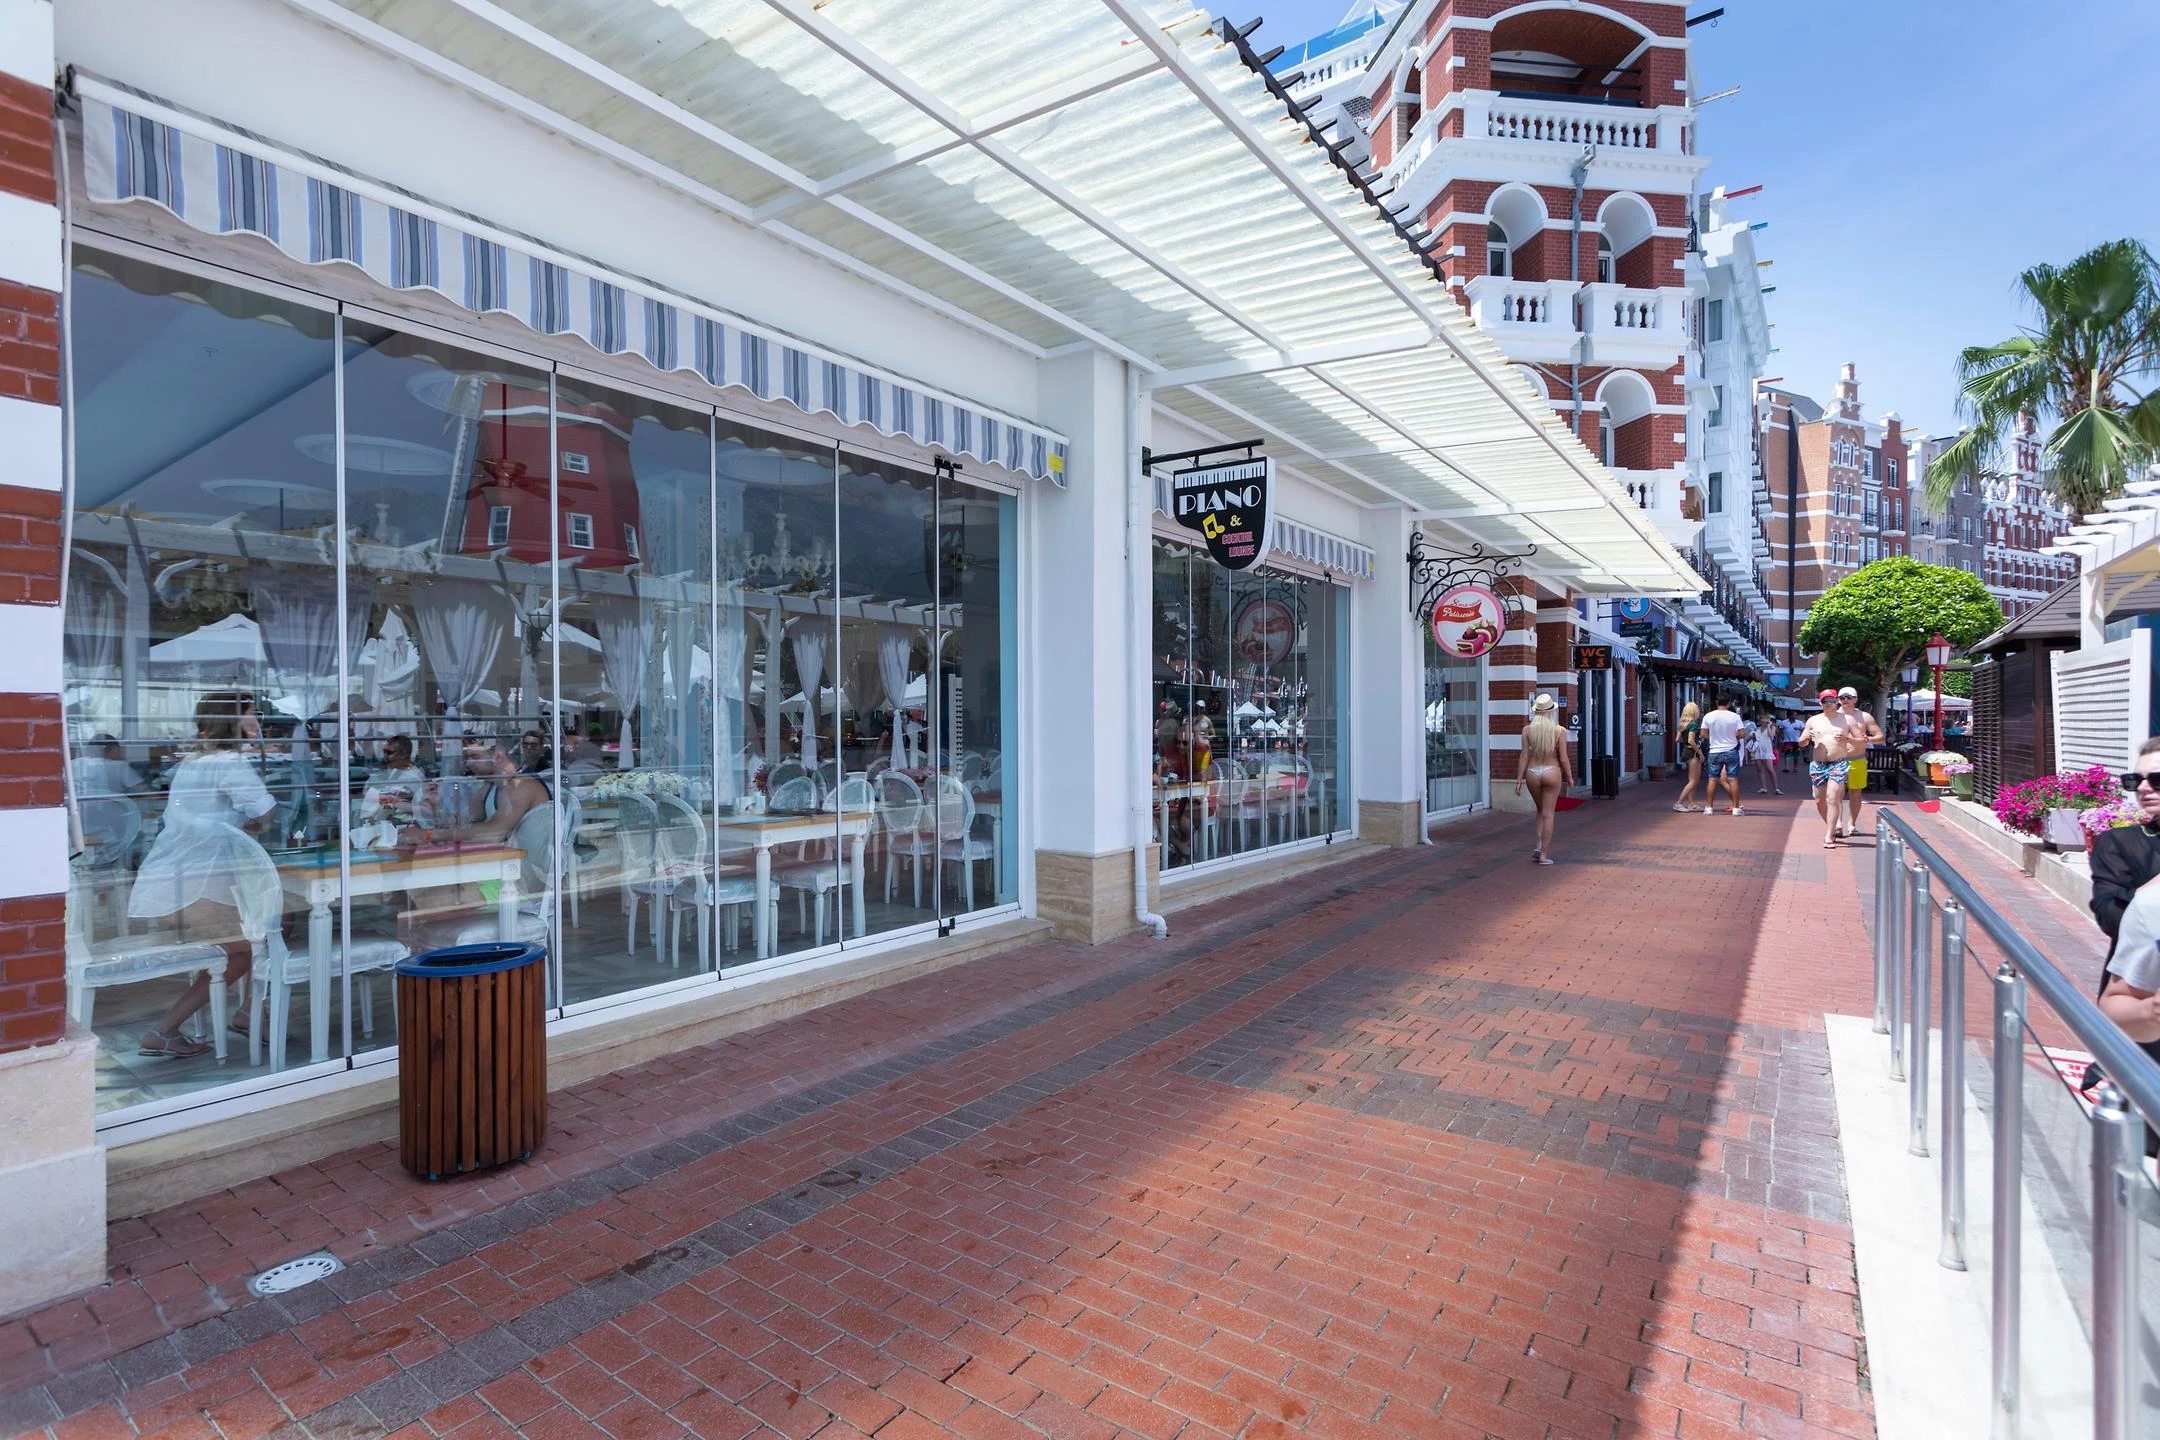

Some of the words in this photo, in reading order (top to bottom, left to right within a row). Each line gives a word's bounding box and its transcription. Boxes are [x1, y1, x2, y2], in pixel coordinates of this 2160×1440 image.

[1179, 485, 1261, 515] PIANO
[1229, 515, 1242, 527] &
[1580, 647, 1605, 657] WC
